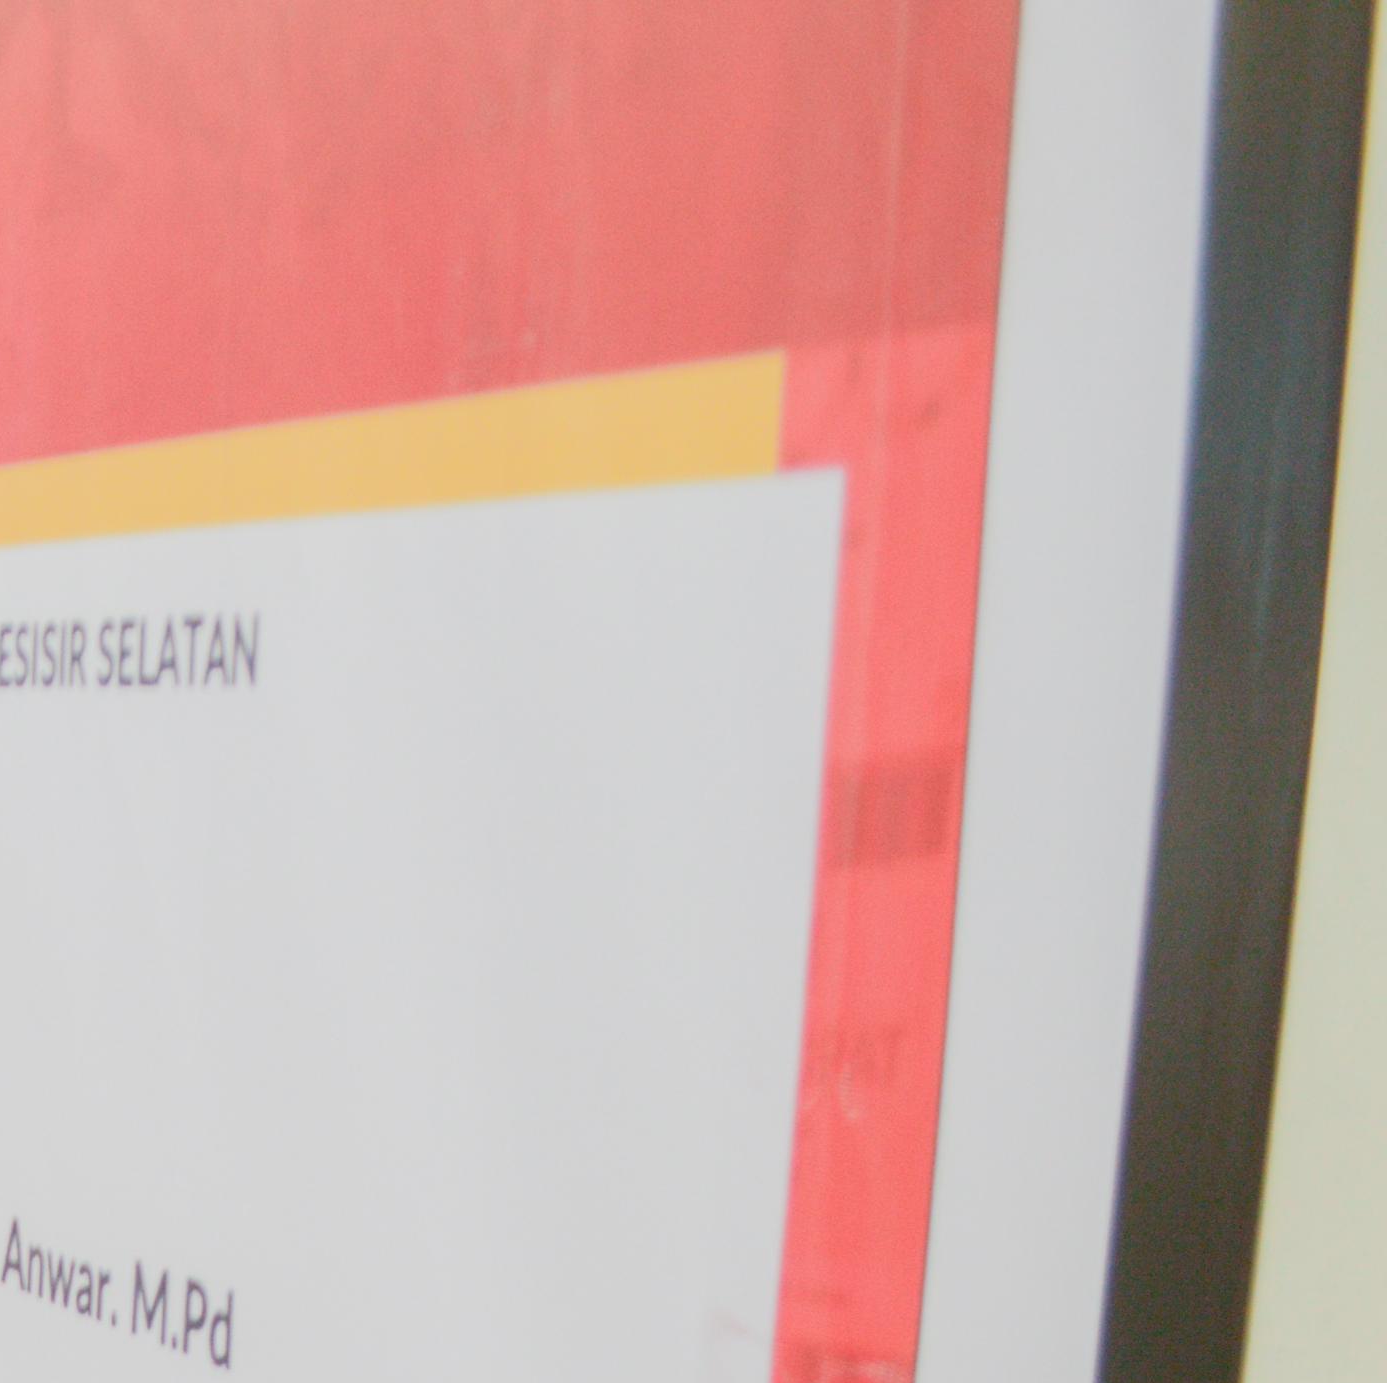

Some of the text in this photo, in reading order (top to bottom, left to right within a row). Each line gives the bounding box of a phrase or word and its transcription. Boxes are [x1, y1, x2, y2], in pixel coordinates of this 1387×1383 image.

[96, 612, 261, 688] SELATAN
[2, 1219, 117, 1327] Anwar.
[132, 1260, 234, 1371] M.Pd
